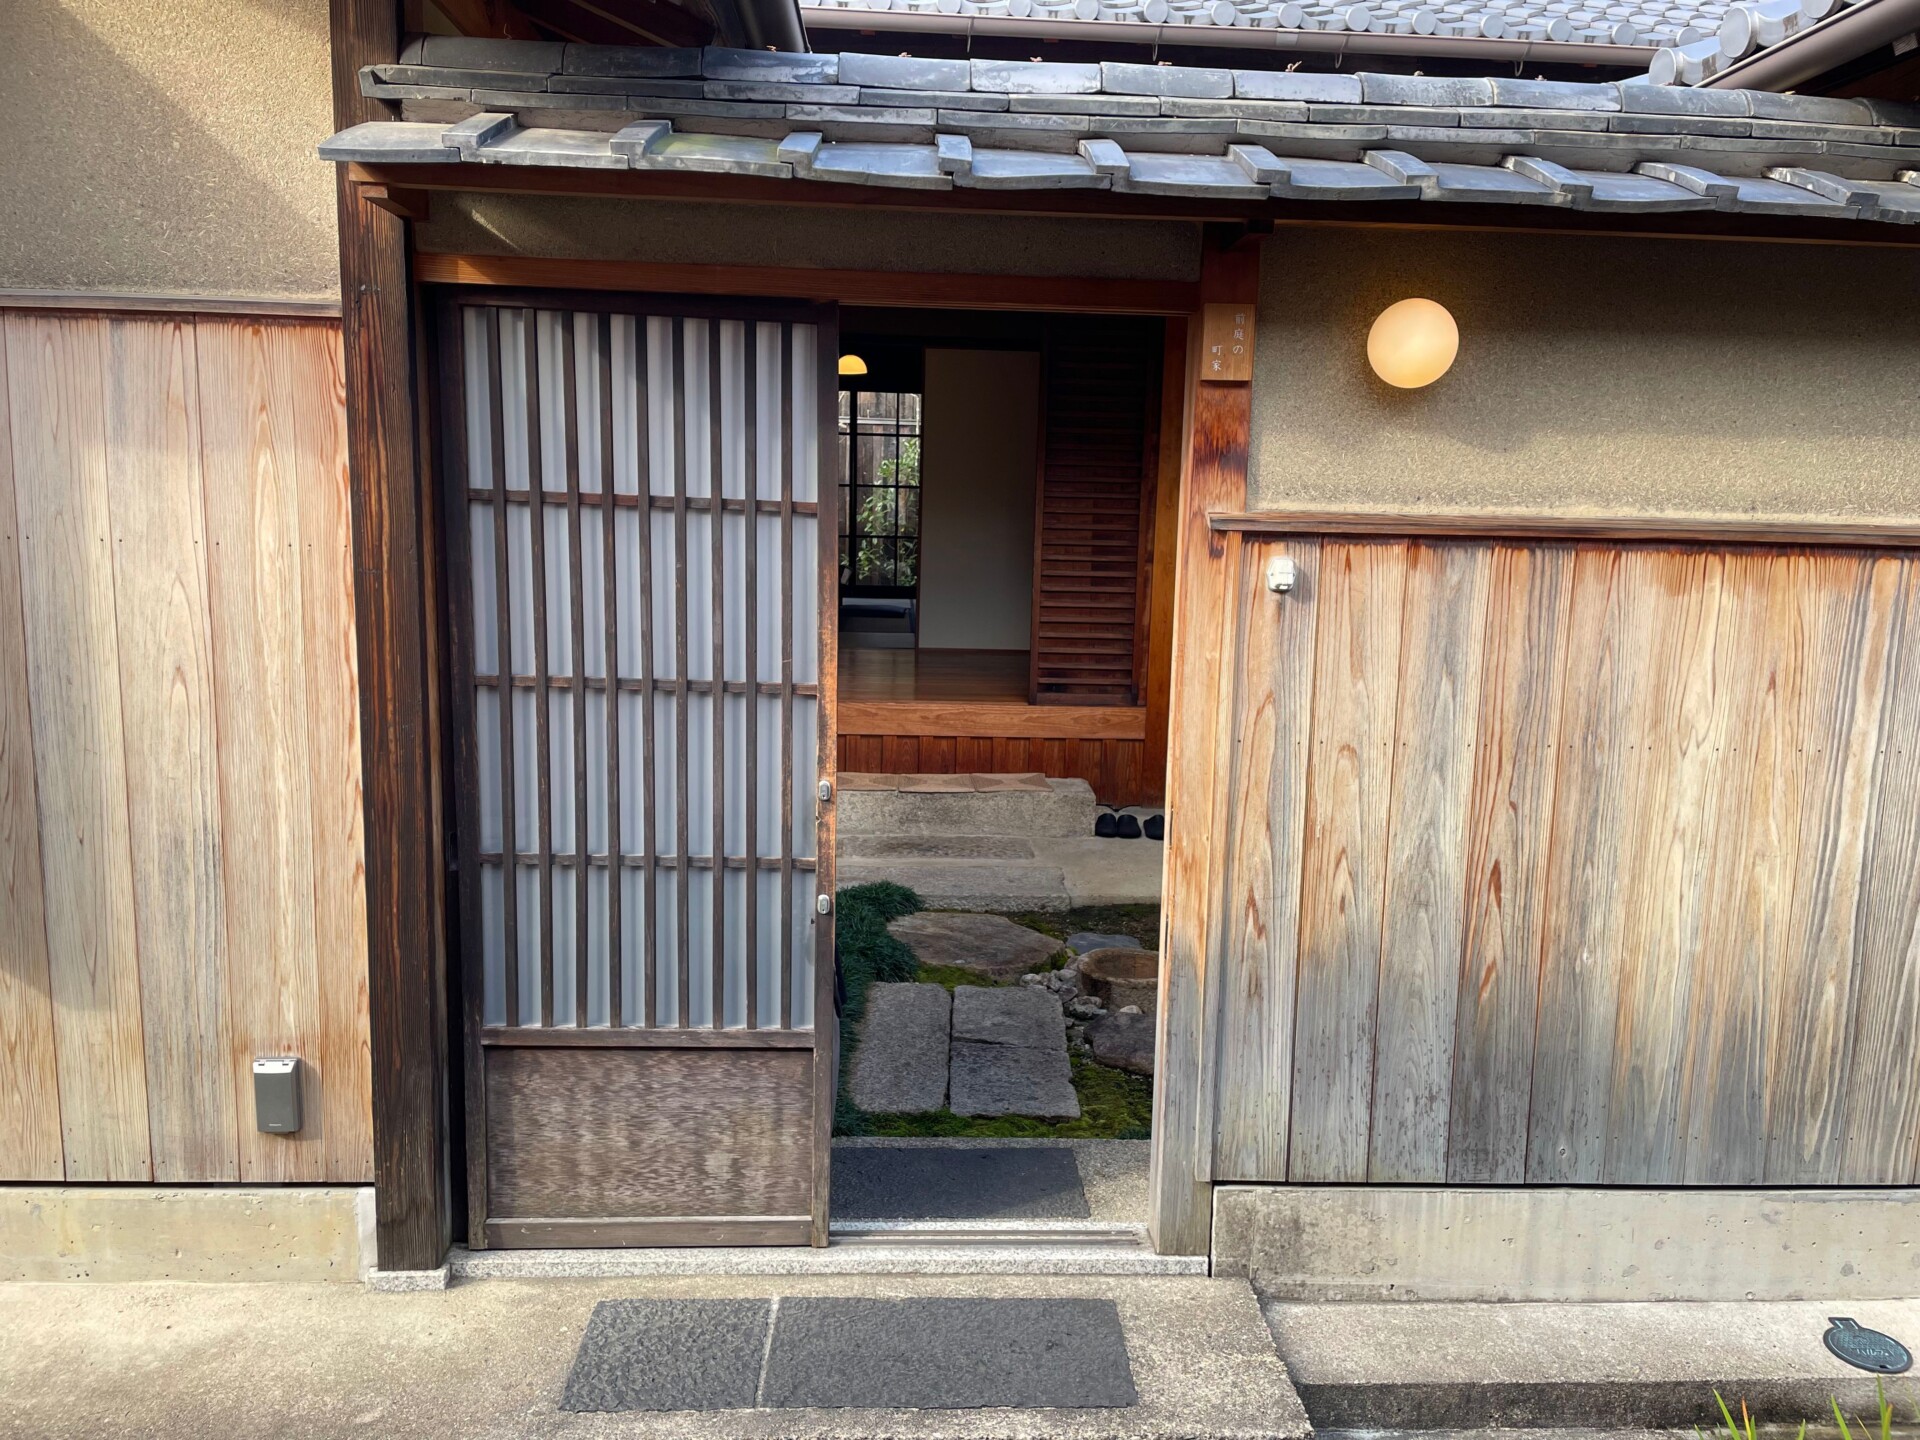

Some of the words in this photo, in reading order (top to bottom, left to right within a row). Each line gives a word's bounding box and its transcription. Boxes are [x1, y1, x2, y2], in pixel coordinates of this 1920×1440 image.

[1232, 313, 1246, 354] 前庭の
[1211, 345, 1223, 372] 町家
